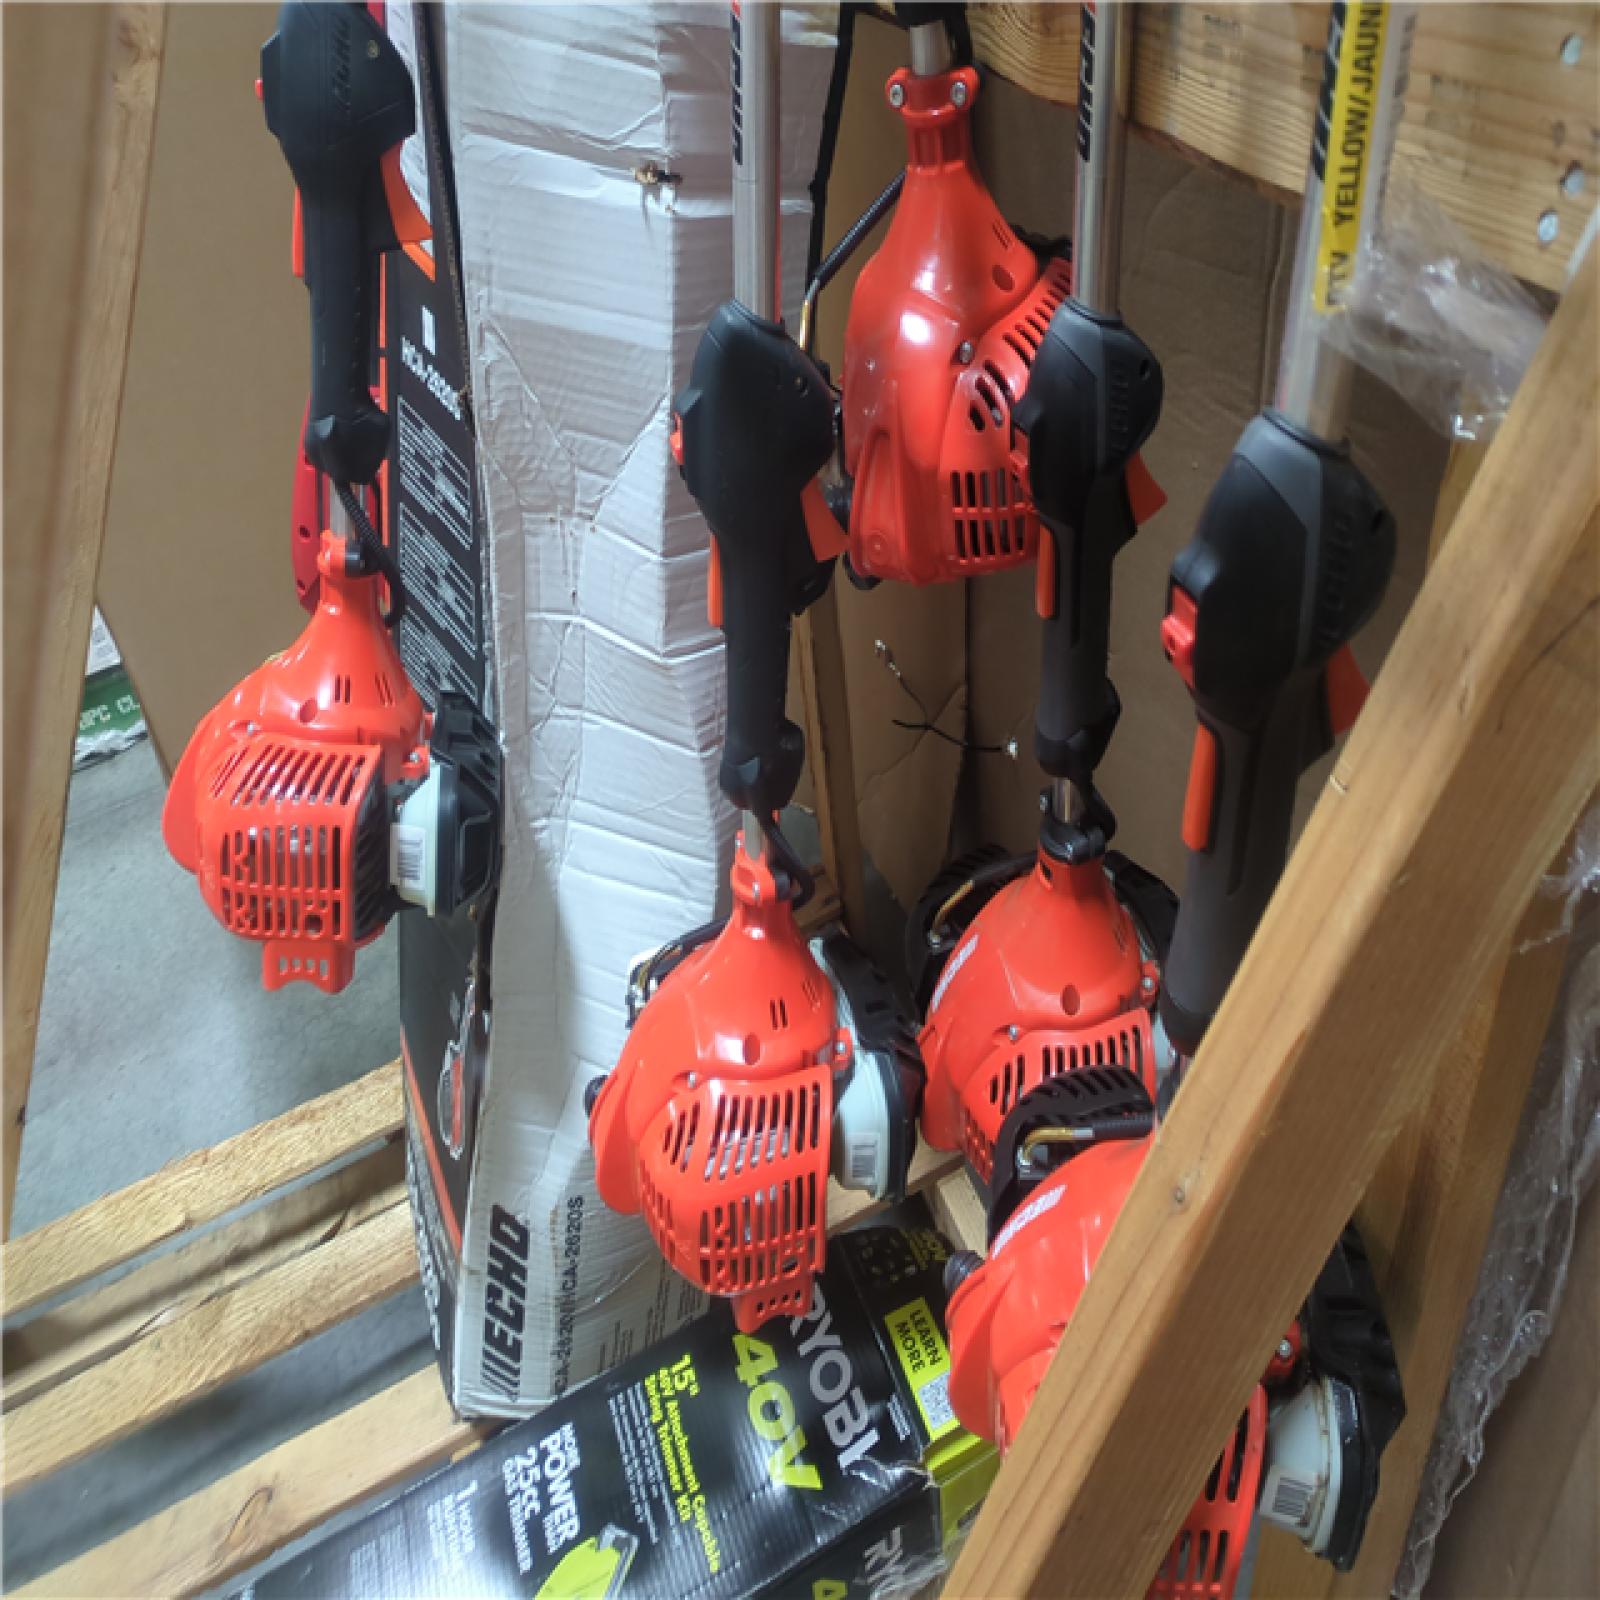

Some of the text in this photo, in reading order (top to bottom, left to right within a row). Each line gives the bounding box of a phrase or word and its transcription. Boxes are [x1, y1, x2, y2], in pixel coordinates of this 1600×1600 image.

[484, 1204, 530, 1364] ECHO
[909, 1309, 943, 1366] LEARN
[895, 1321, 926, 1373] MORE
[732, 1334, 823, 1489] 40V
[539, 1430, 580, 1541] POWER
